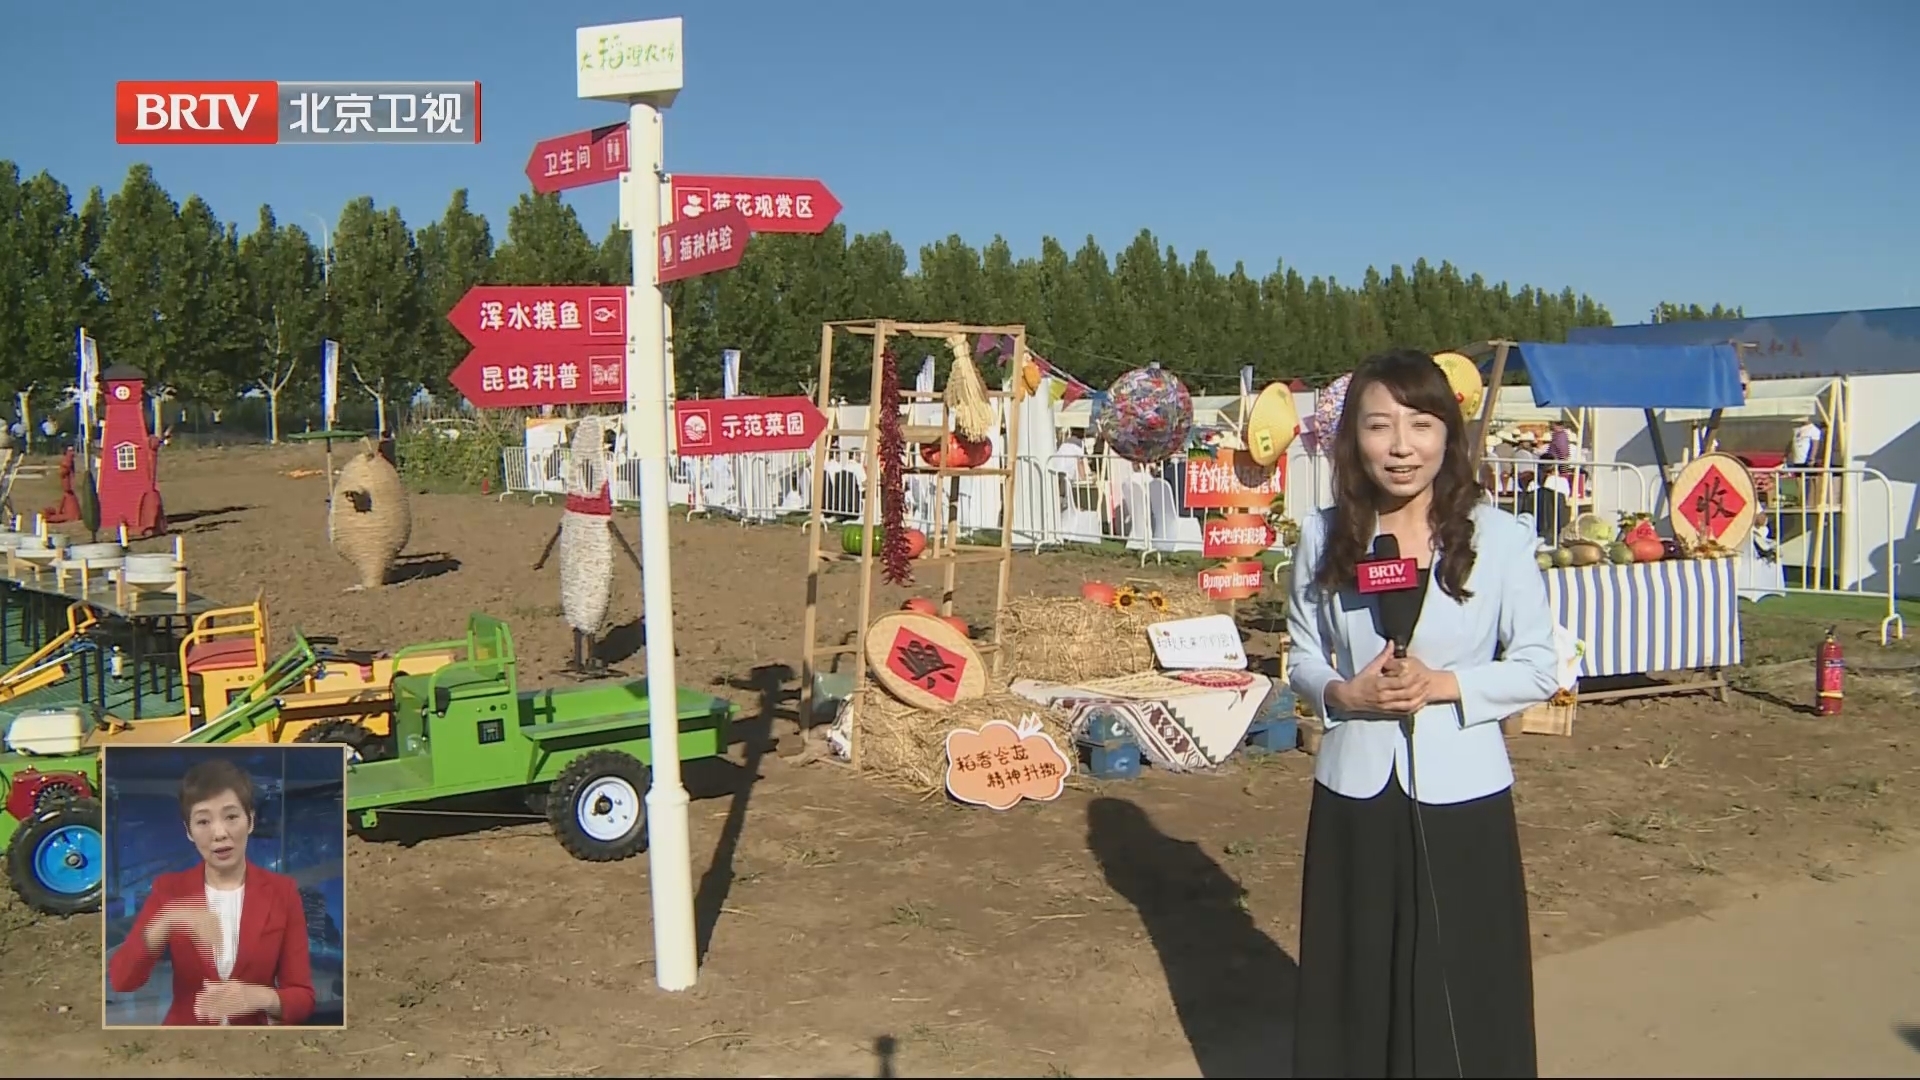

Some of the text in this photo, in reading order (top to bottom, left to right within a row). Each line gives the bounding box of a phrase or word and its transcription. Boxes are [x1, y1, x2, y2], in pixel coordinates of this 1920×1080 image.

[544, 146, 591, 177] 卫生间
[712, 193, 814, 218] 荷花观赏区
[679, 225, 733, 261] 插秧体验
[480, 301, 582, 331] 浑水摸鱼
[482, 363, 581, 392] 昆虫科普
[721, 412, 805, 438] 示范菜园
[1696, 477, 1737, 526] 收
[1208, 526, 1267, 546] 大地的浪漫
[1203, 570, 1261, 593] Bumper Harvest
[1368, 563, 1405, 579] BRTV
